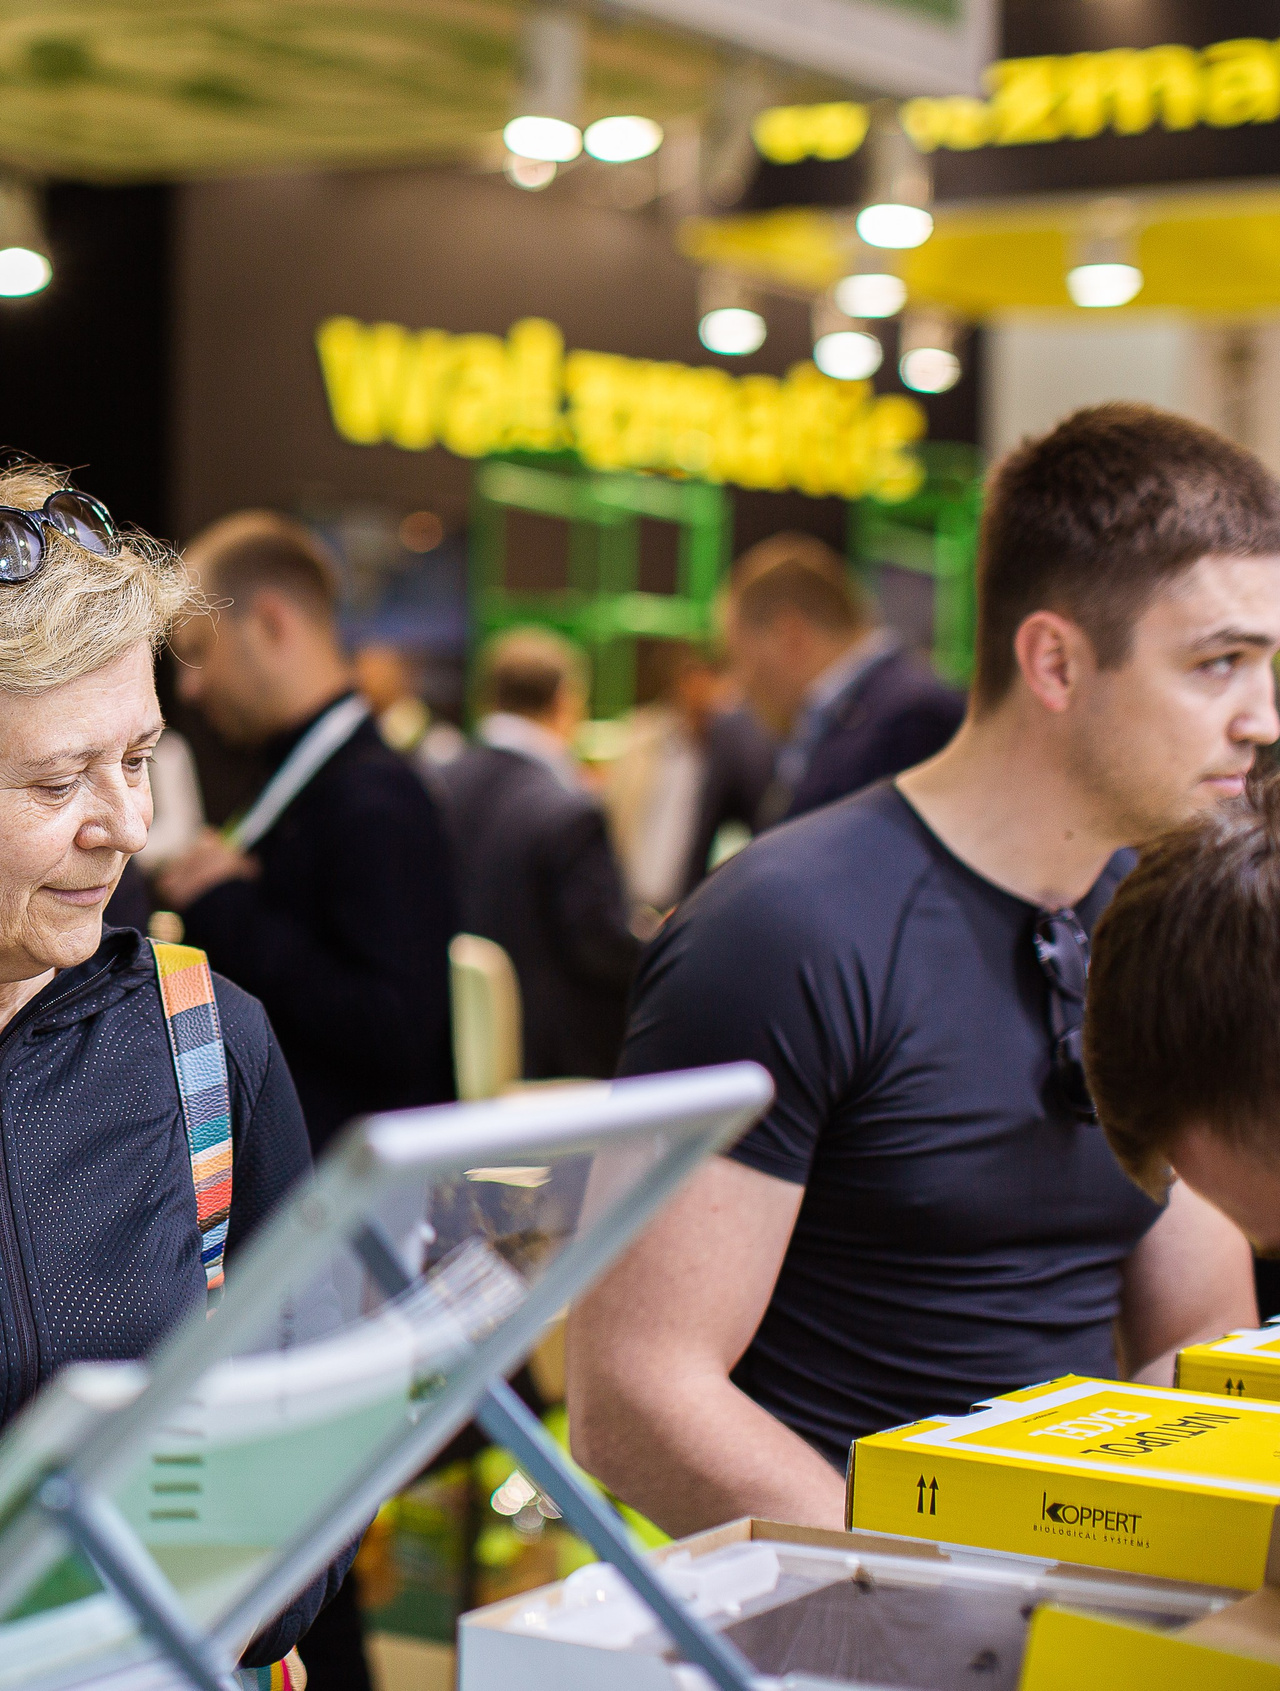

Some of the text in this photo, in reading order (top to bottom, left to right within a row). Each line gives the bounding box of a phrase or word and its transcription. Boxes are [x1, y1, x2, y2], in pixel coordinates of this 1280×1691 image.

[1028, 1407, 1153, 1441] EXCEL
[1080, 1411, 1241, 1458] NATUPOL
[1033, 1524, 1151, 1549] BIOLOGICAL SYSTEMS
